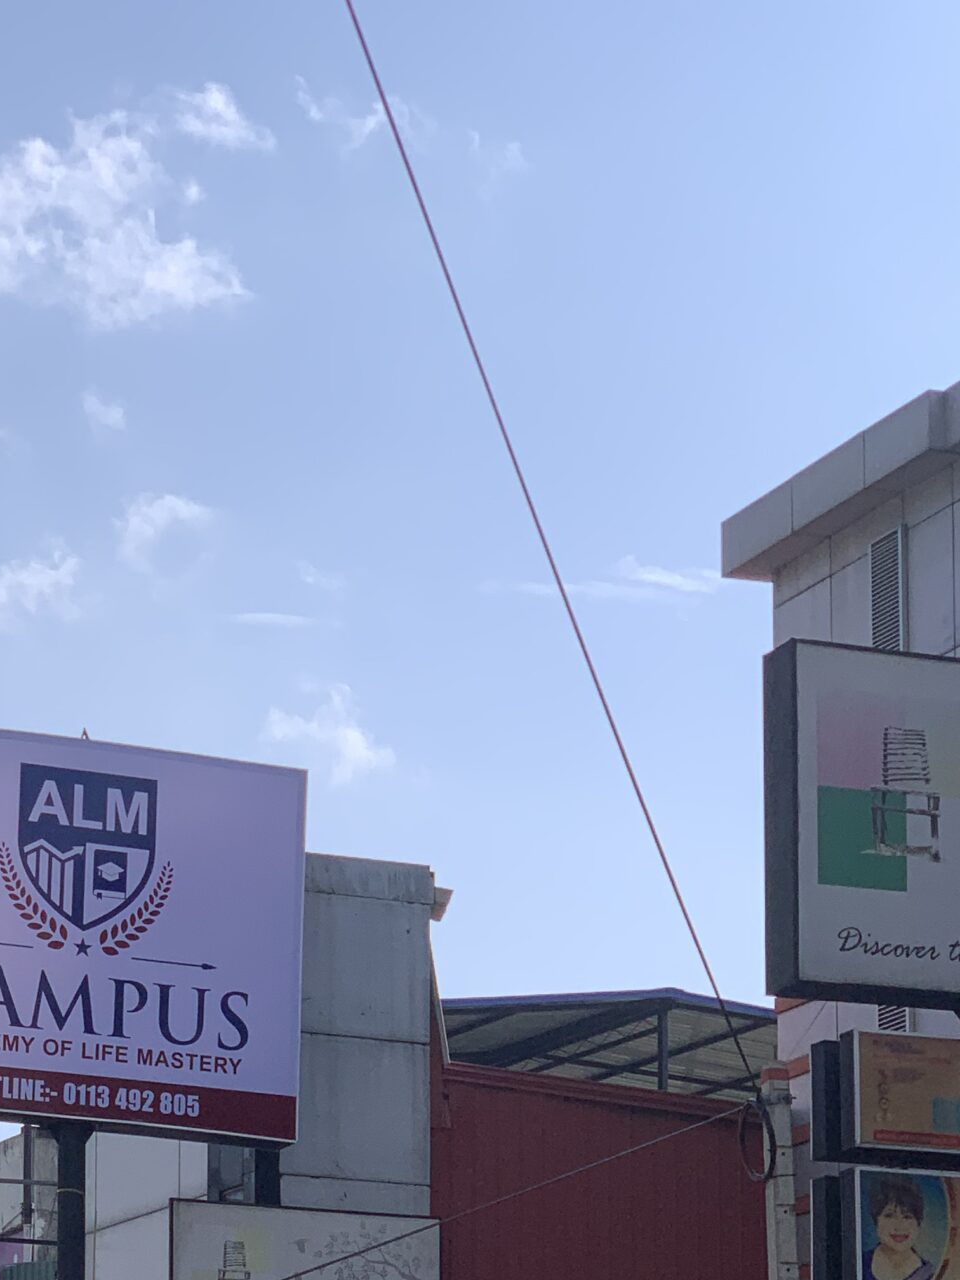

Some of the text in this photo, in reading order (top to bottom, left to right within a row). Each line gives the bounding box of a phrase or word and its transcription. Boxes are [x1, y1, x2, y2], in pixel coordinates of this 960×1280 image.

[28, 780, 150, 836] ALM
[838, 927, 940, 961] Discover
[43, 1038, 72, 1057] OF
[81, 1042, 128, 1064] LIFE
[136, 1048, 243, 1075] MASTERY
[63, 1082, 110, 1108] 0113
[115, 1088, 157, 1112] 492
[160, 1092, 200, 1117] 805
